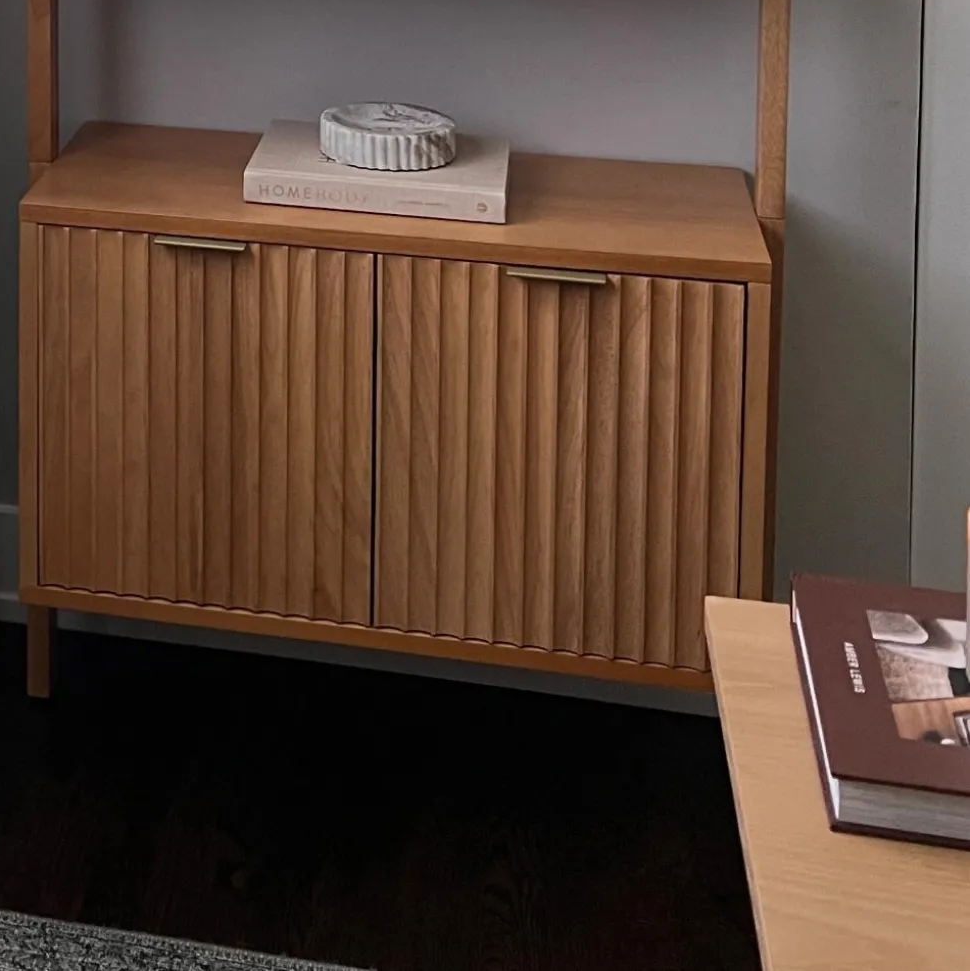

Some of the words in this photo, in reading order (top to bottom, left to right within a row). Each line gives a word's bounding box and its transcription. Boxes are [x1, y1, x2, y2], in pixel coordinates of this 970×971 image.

[258, 184, 368, 204] HOMEBODY
[844, 641, 859, 668] AMBER
[849, 669, 866, 693] LEWIS
